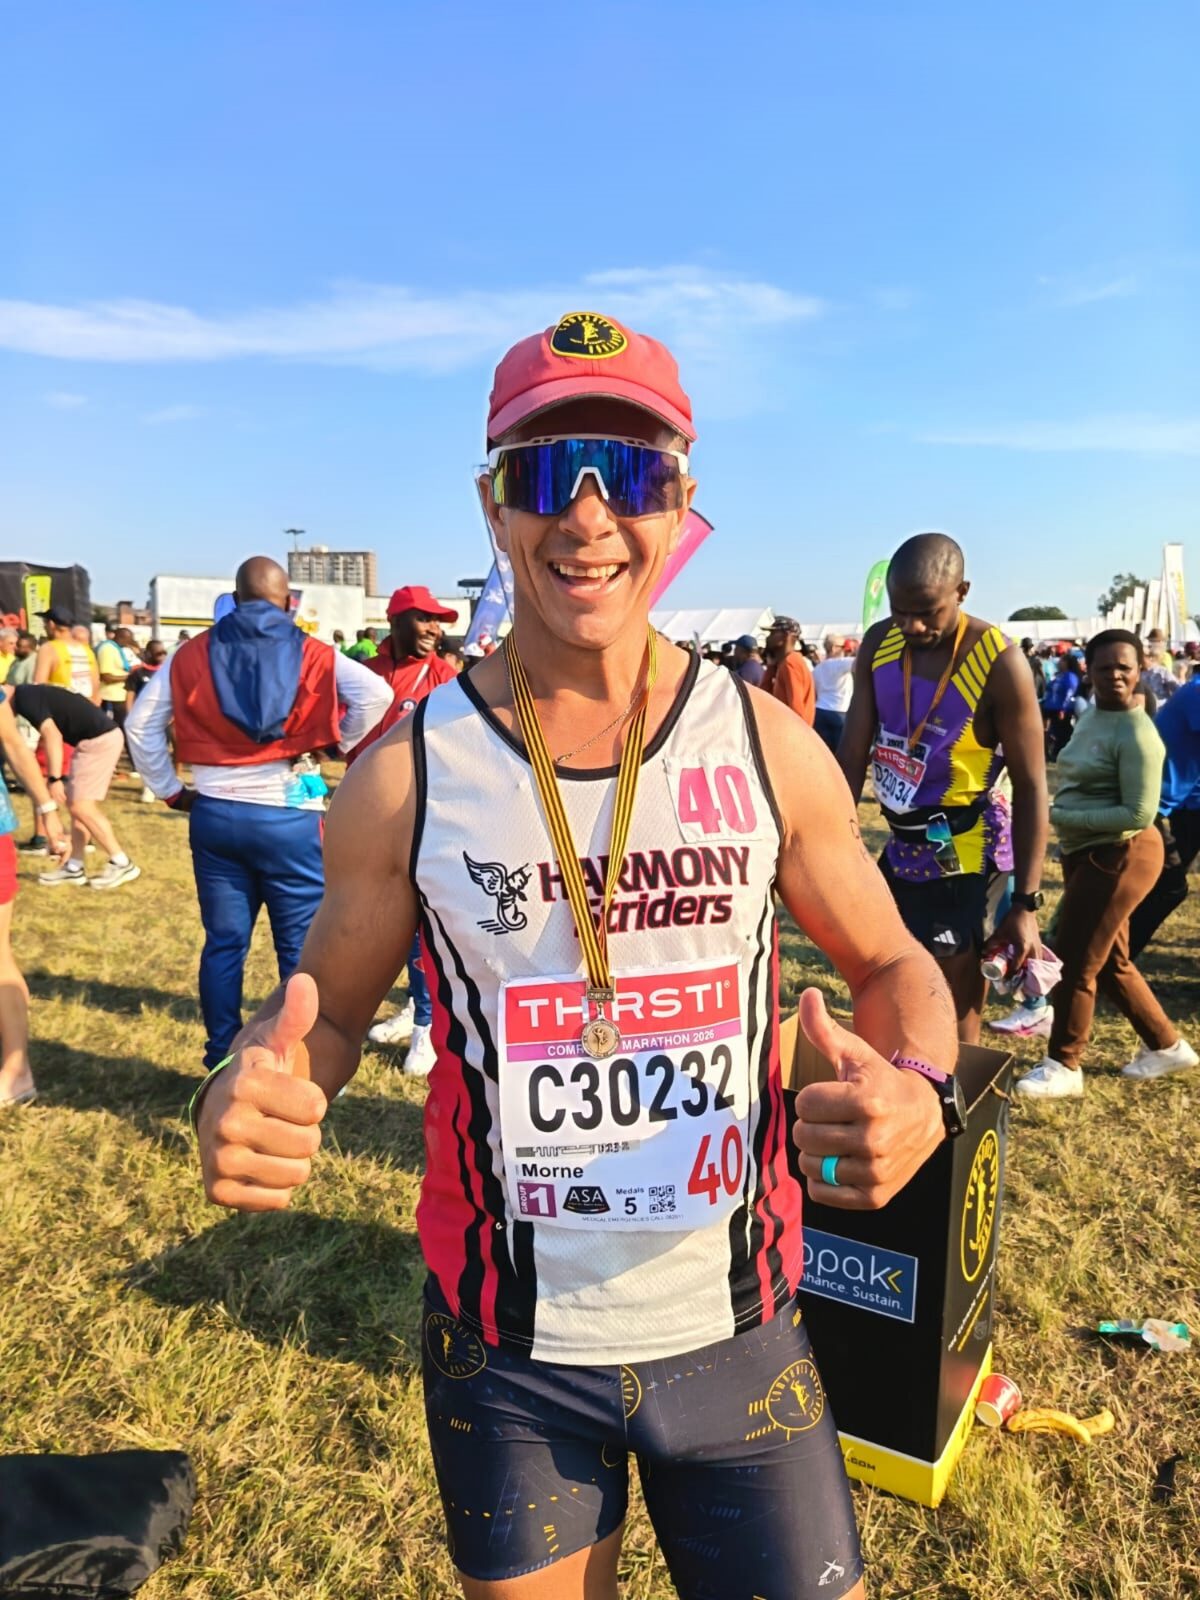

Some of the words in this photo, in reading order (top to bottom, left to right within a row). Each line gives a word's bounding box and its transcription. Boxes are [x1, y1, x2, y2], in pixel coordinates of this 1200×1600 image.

[678, 765, 757, 834] 40
[537, 846, 750, 902] HARMONY
[622, 1033, 691, 1051] MARATHON
[692, 1029, 715, 1043] 2026
[528, 1044, 735, 1133] C30232
[521, 1163, 584, 1179] Morne
[687, 1124, 743, 1206] 40
[519, 1185, 529, 1213] GROUP
[529, 1186, 550, 1215] 1
[568, 1188, 604, 1203] ASA
[615, 1187, 645, 1195] Medals
[624, 1197, 638, 1216] 5
[852, 1285, 905, 1311] Sustain.
